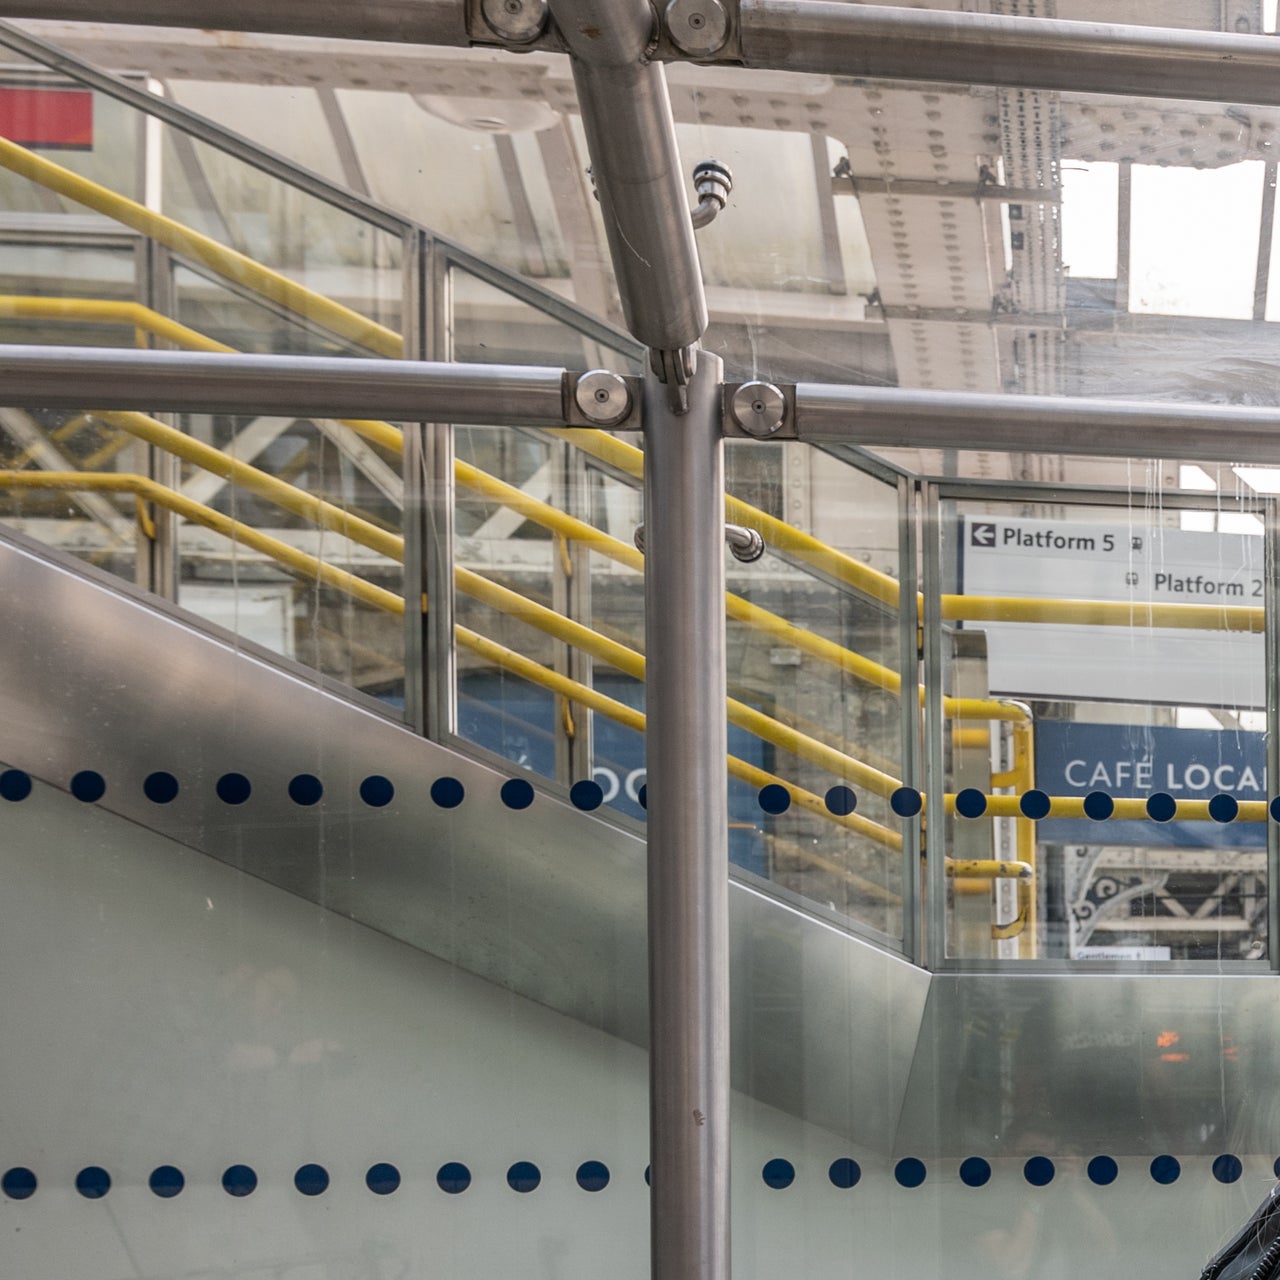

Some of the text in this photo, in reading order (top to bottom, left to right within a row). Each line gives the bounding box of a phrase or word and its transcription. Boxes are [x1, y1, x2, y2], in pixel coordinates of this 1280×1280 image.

[1003, 528, 1115, 551] Platform 5
[1154, 573, 1263, 597] Platform 2
[1064, 754, 1267, 792] CAFÉ LOCA
